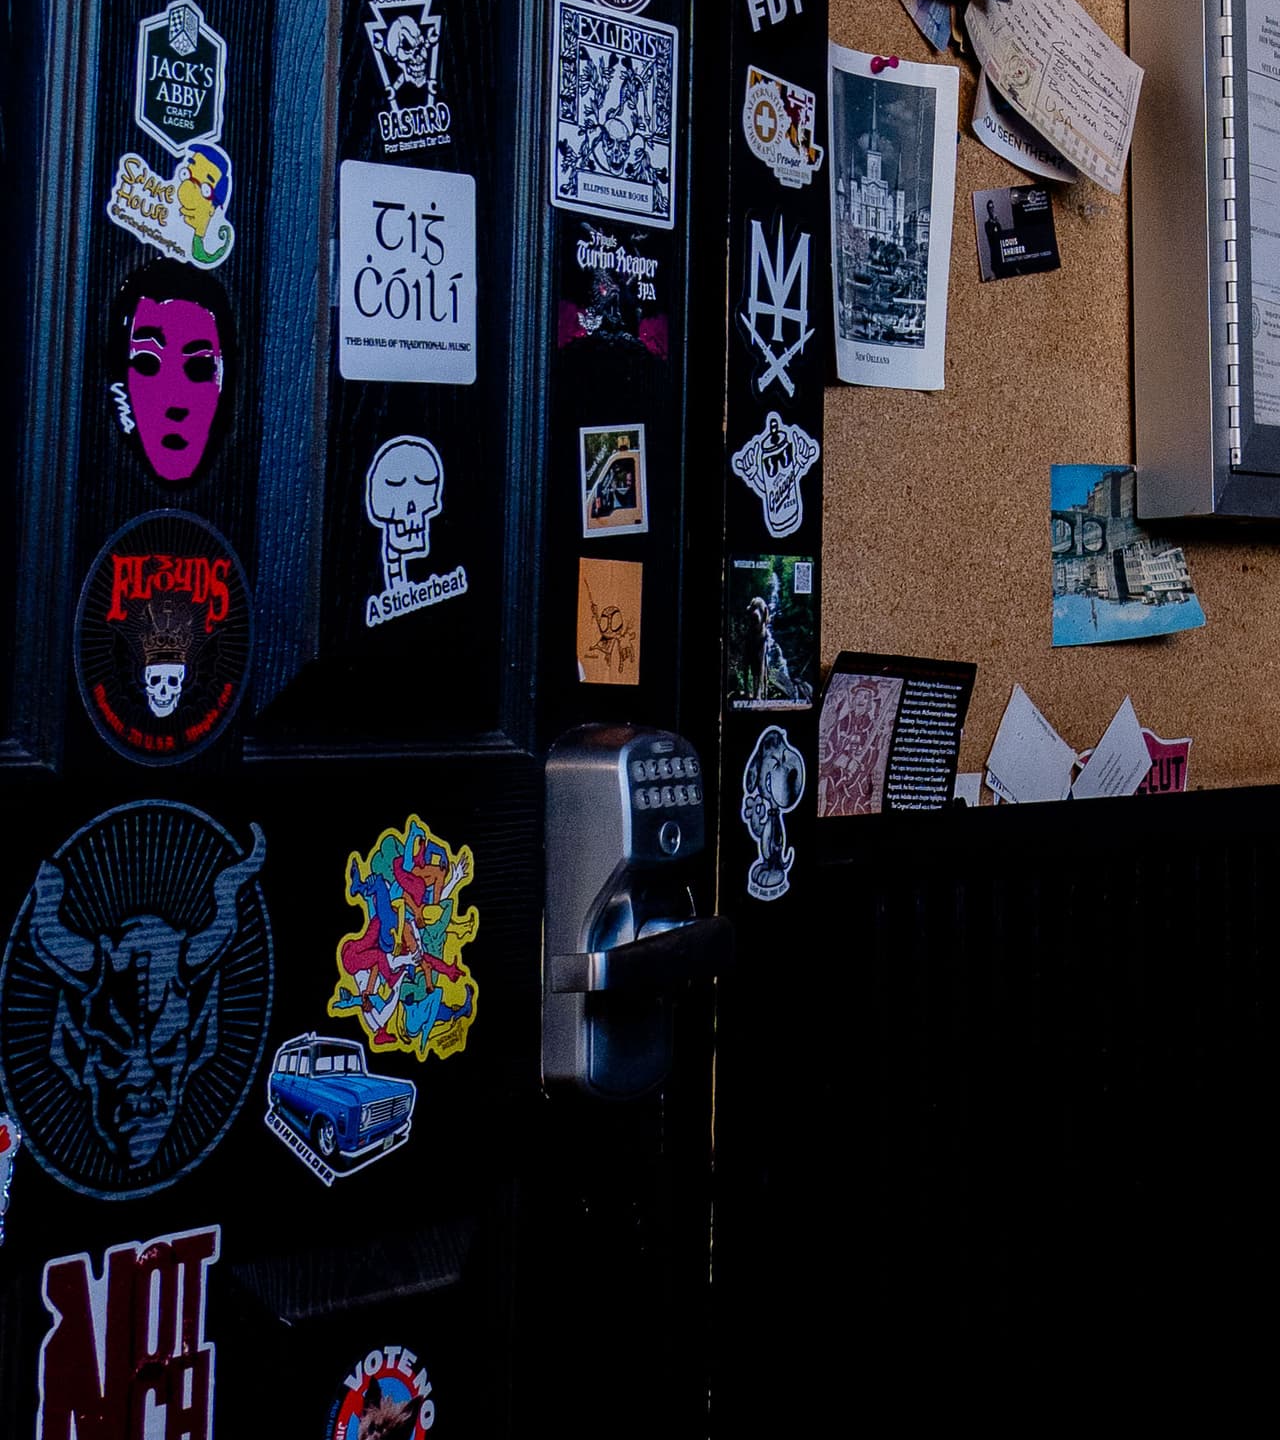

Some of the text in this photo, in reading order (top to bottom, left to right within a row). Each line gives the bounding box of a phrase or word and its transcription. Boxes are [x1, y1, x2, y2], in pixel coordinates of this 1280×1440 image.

[578, 15, 657, 57] EX LIBRIS
[149, 55, 214, 89] JACK'S
[156, 81, 207, 117] ABBY
[166, 106, 193, 119] CRAFT
[163, 114, 195, 130] LAGERS
[378, 101, 450, 142] BASTARD
[998, 123, 1023, 150] SEEN
[616, 245, 658, 280] Reaper
[368, 570, 465, 621] A Stickerbeat
[344, 1345, 435, 1431] VOTE NO
